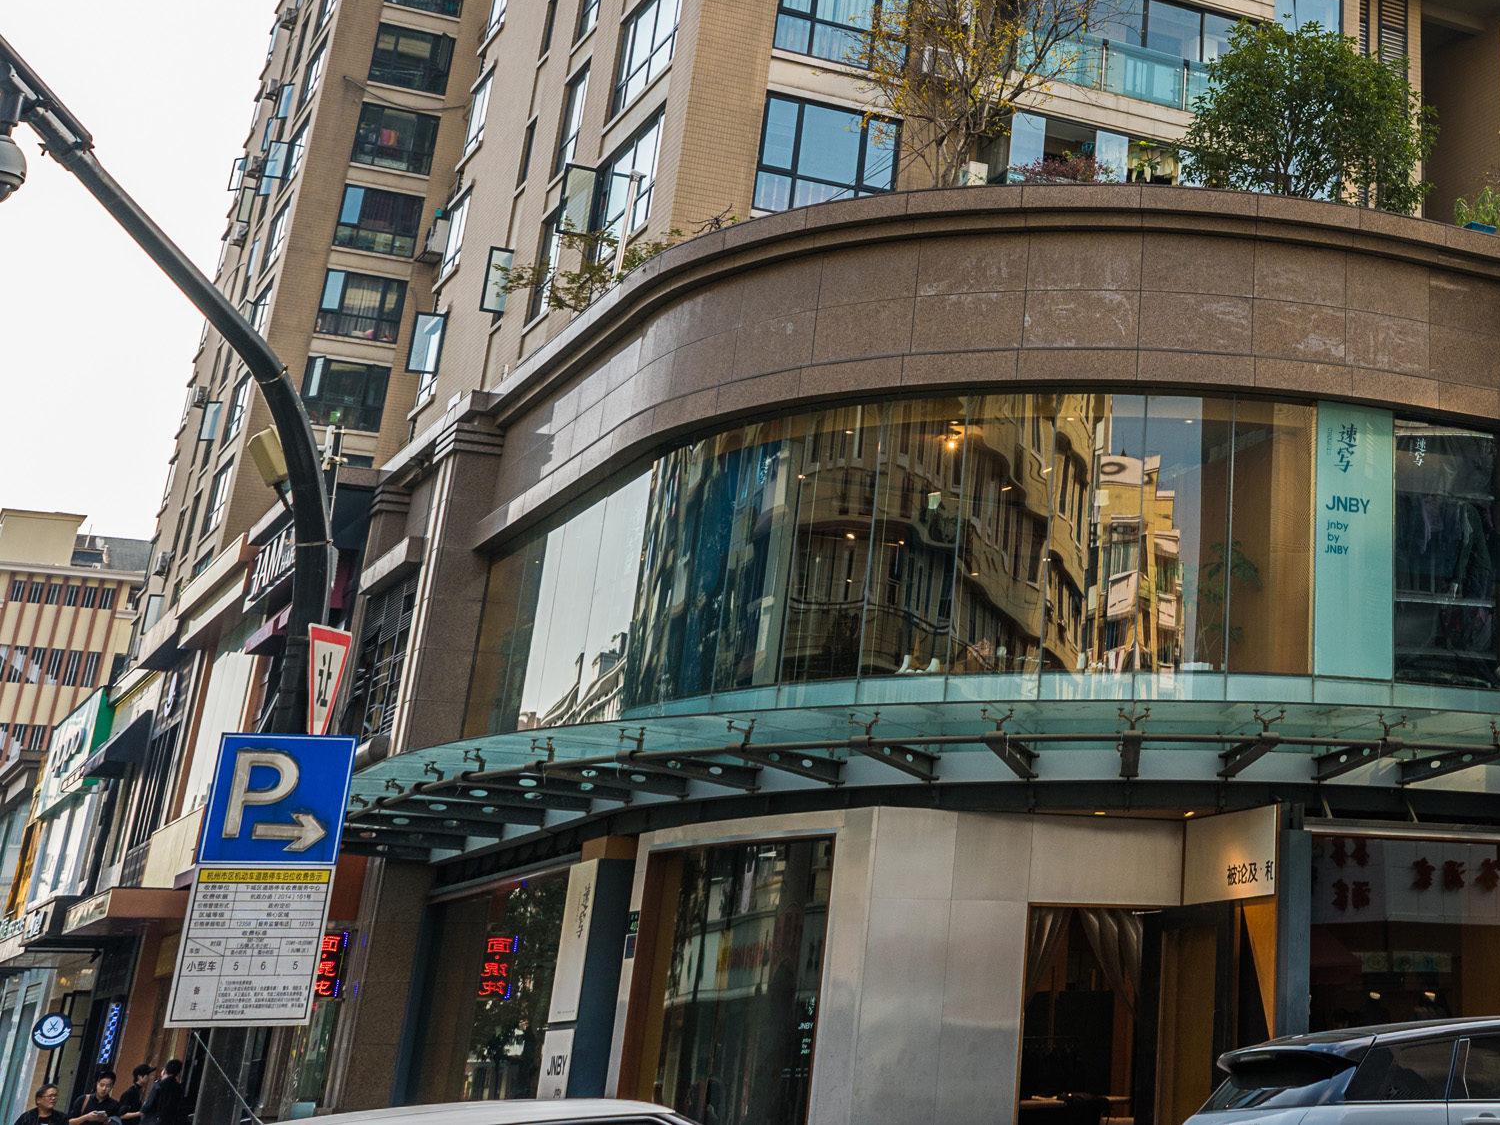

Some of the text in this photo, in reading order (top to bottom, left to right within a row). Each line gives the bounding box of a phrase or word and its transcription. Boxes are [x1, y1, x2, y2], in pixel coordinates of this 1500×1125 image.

[1334, 423, 1358, 473] 速写
[1413, 437, 1426, 467] 速写
[1326, 495, 1370, 514] JNBY
[1327, 520, 1349, 532] jnby
[1327, 532, 1340, 543] by
[1325, 545, 1349, 555] JNBY
[316, 652, 333, 708] 让
[222, 749, 300, 838] P
[206, 871, 323, 882] 杭州市区机动车道路停车泊位收费告示
[186, 961, 217, 972] 小型车
[233, 961, 239, 971] 5
[260, 961, 266, 971] 6
[292, 960, 299, 970] 5
[546, 1054, 568, 1076] JNBY
